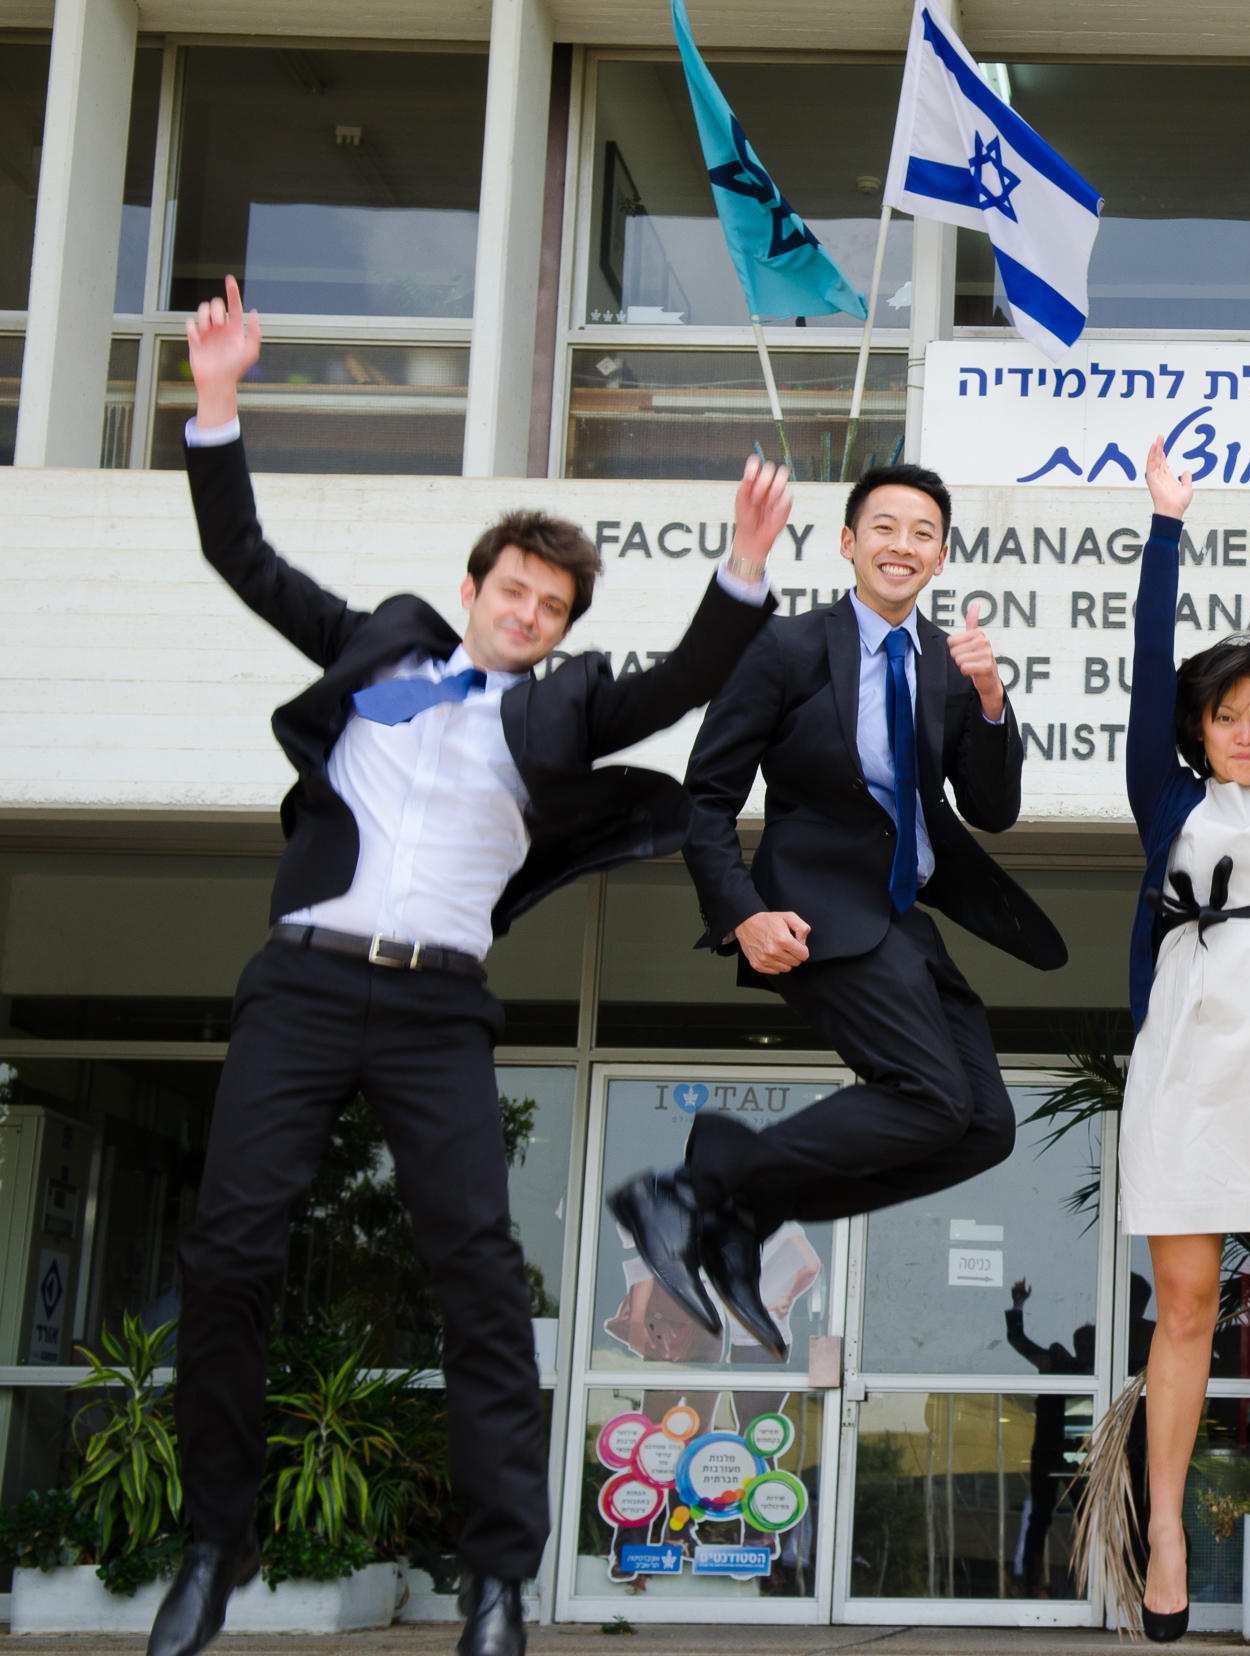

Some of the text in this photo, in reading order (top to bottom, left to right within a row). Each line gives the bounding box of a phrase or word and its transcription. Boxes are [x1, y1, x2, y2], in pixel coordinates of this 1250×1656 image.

[958, 362, 1185, 399] לתלמידיה
[595, 520, 815, 561] FACUY
[931, 589, 1037, 628] EON
[655, 1084, 790, 1113] I TAU
[958, 1257, 991, 1271] כניסה
[702, 1465, 741, 1473] מעורבות
[702, 1476, 739, 1484] חברתית
[700, 1552, 766, 1564] הסטודנטים
